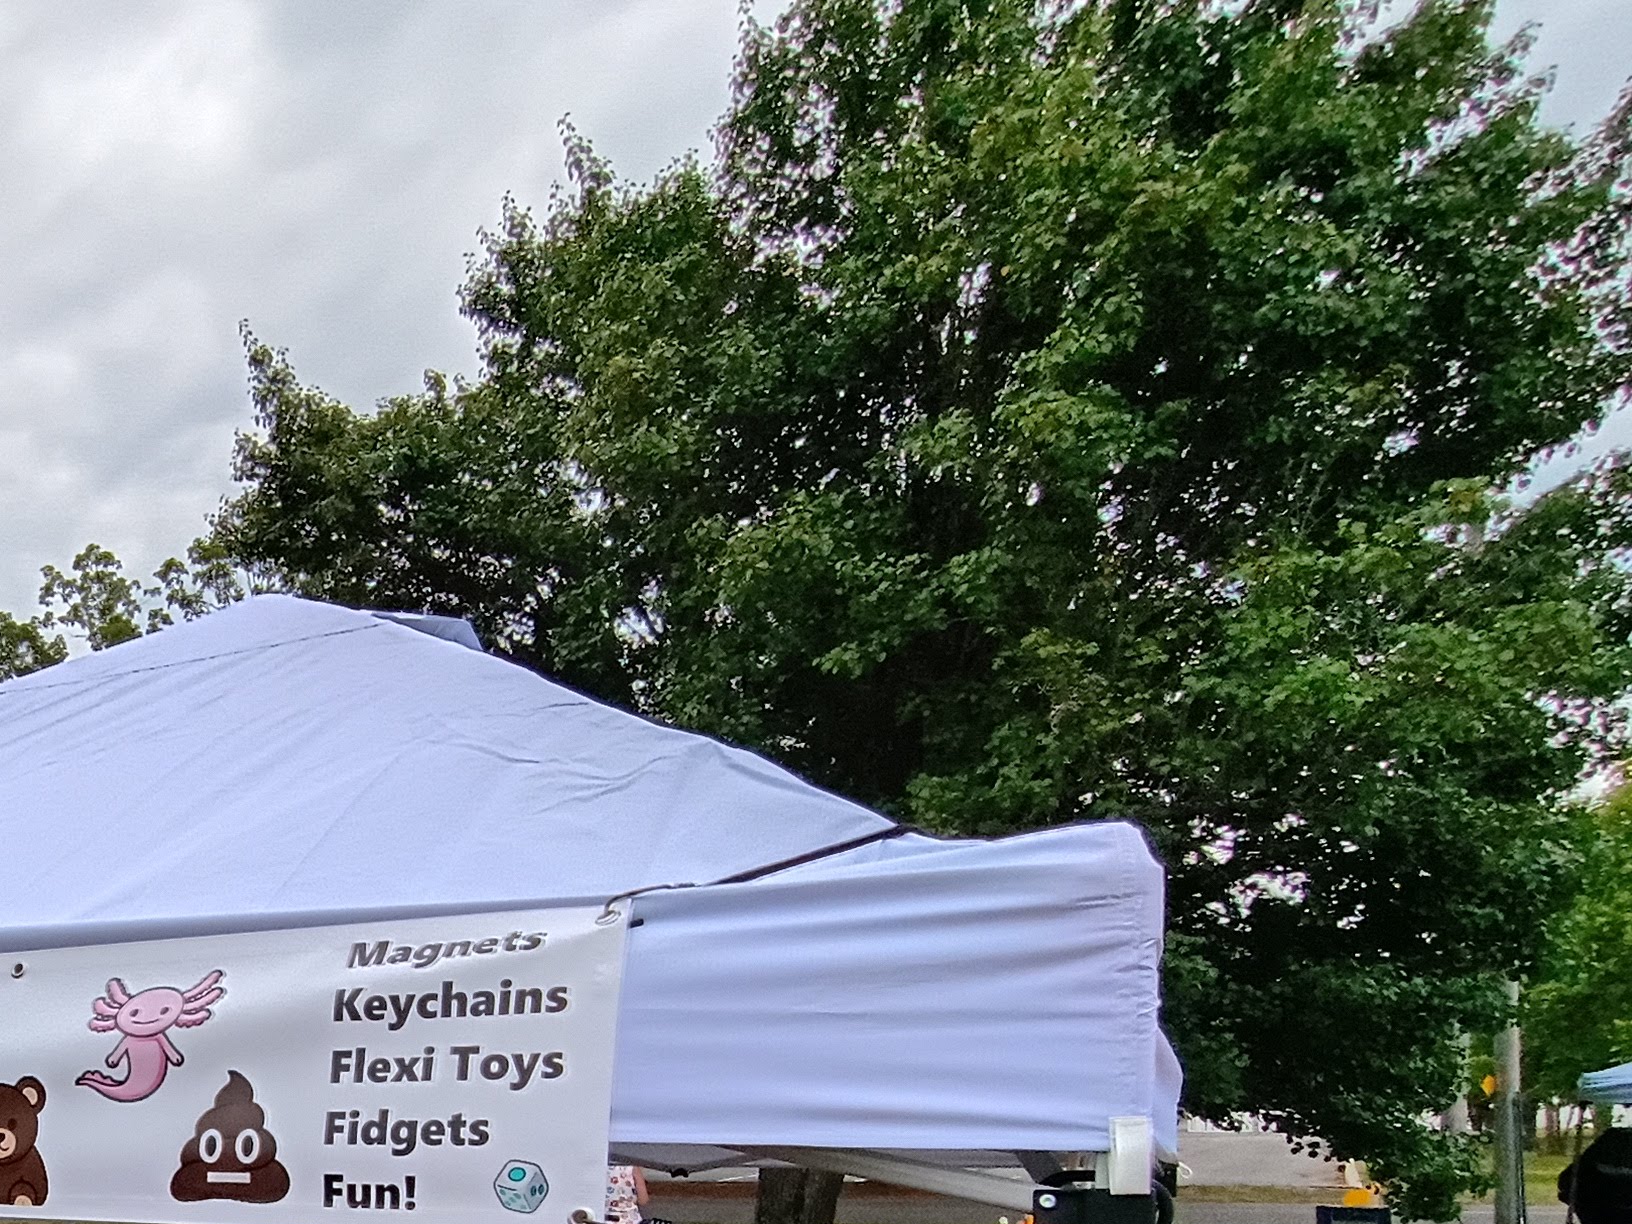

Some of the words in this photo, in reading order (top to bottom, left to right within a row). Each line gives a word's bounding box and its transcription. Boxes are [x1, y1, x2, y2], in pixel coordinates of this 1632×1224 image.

[347, 931, 548, 969] Magnets
[332, 978, 570, 1031] Keychains
[329, 1046, 436, 1084] Flexi
[449, 1045, 565, 1091] Toys
[323, 1108, 491, 1157] Fidgets
[322, 1173, 417, 1211] Fun!
